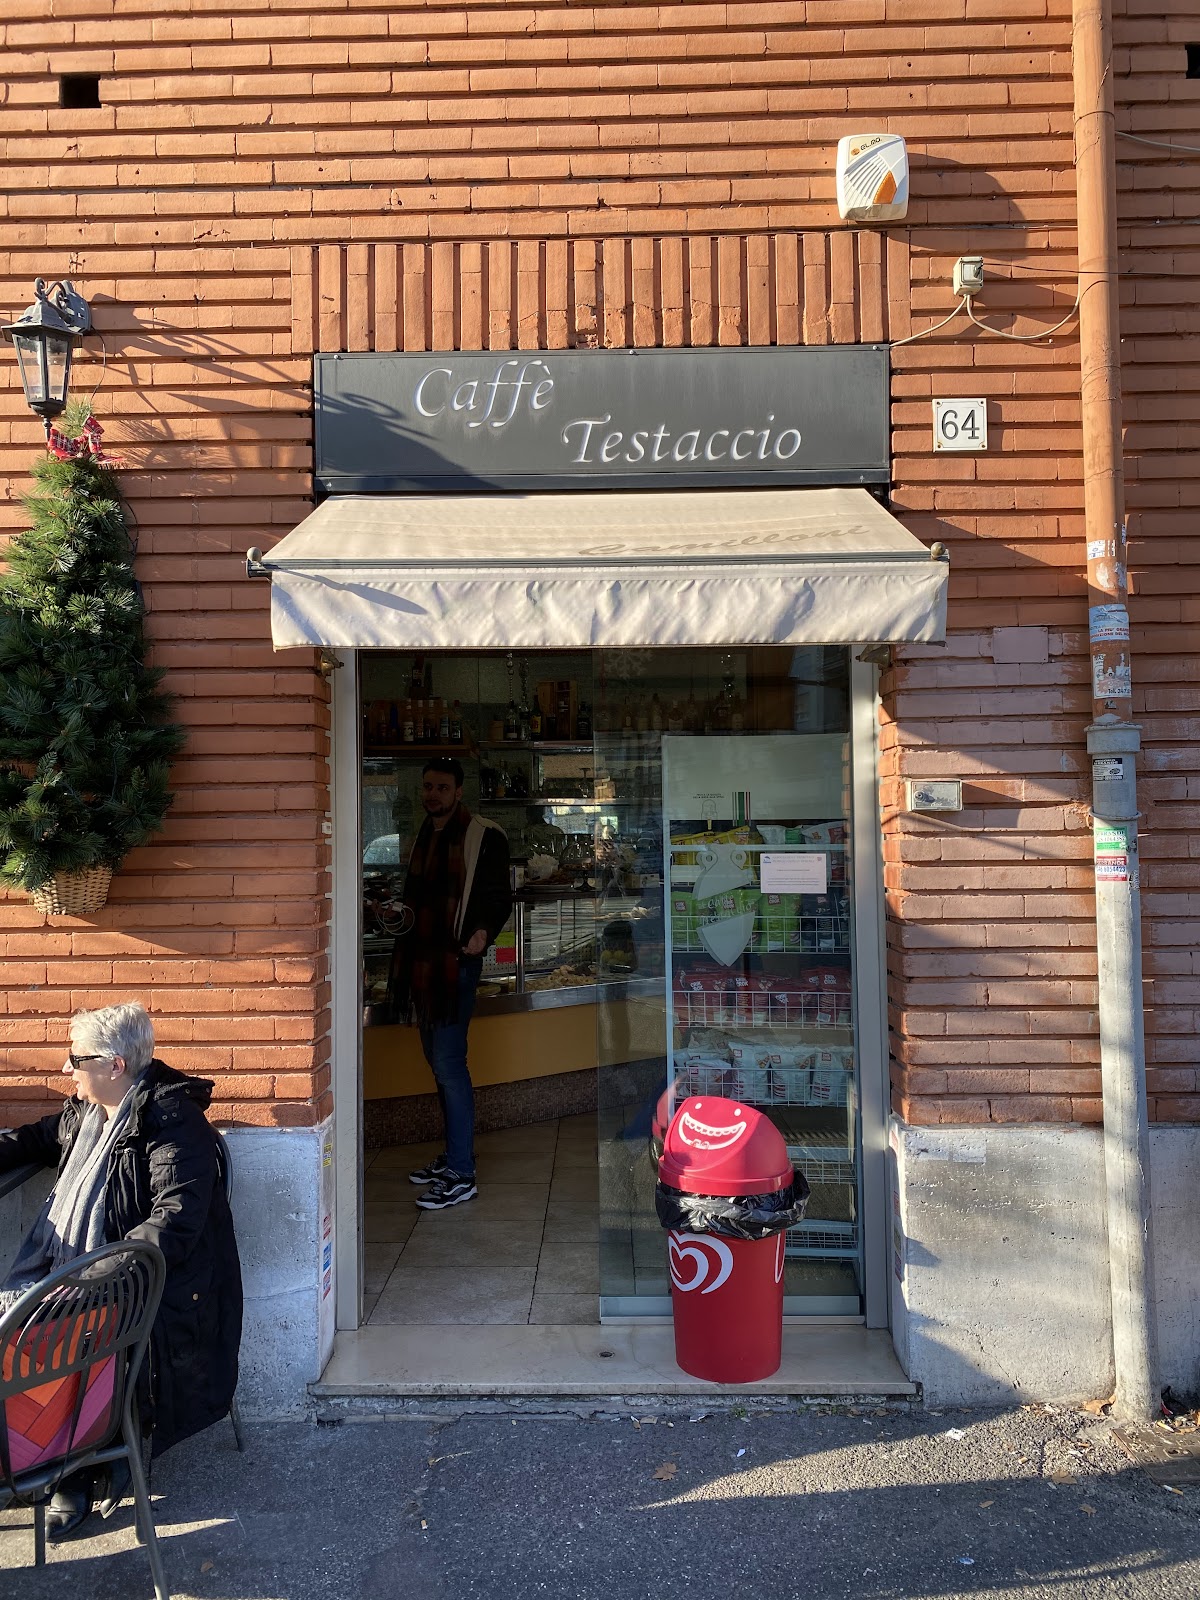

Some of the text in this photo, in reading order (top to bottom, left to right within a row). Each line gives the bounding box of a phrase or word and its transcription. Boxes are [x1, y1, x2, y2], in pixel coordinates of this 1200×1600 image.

[413, 359, 556, 428] Caffè
[561, 410, 803, 464] Testaccio
[941, 409, 980, 440] 64
[578, 524, 869, 556] Camilloni
